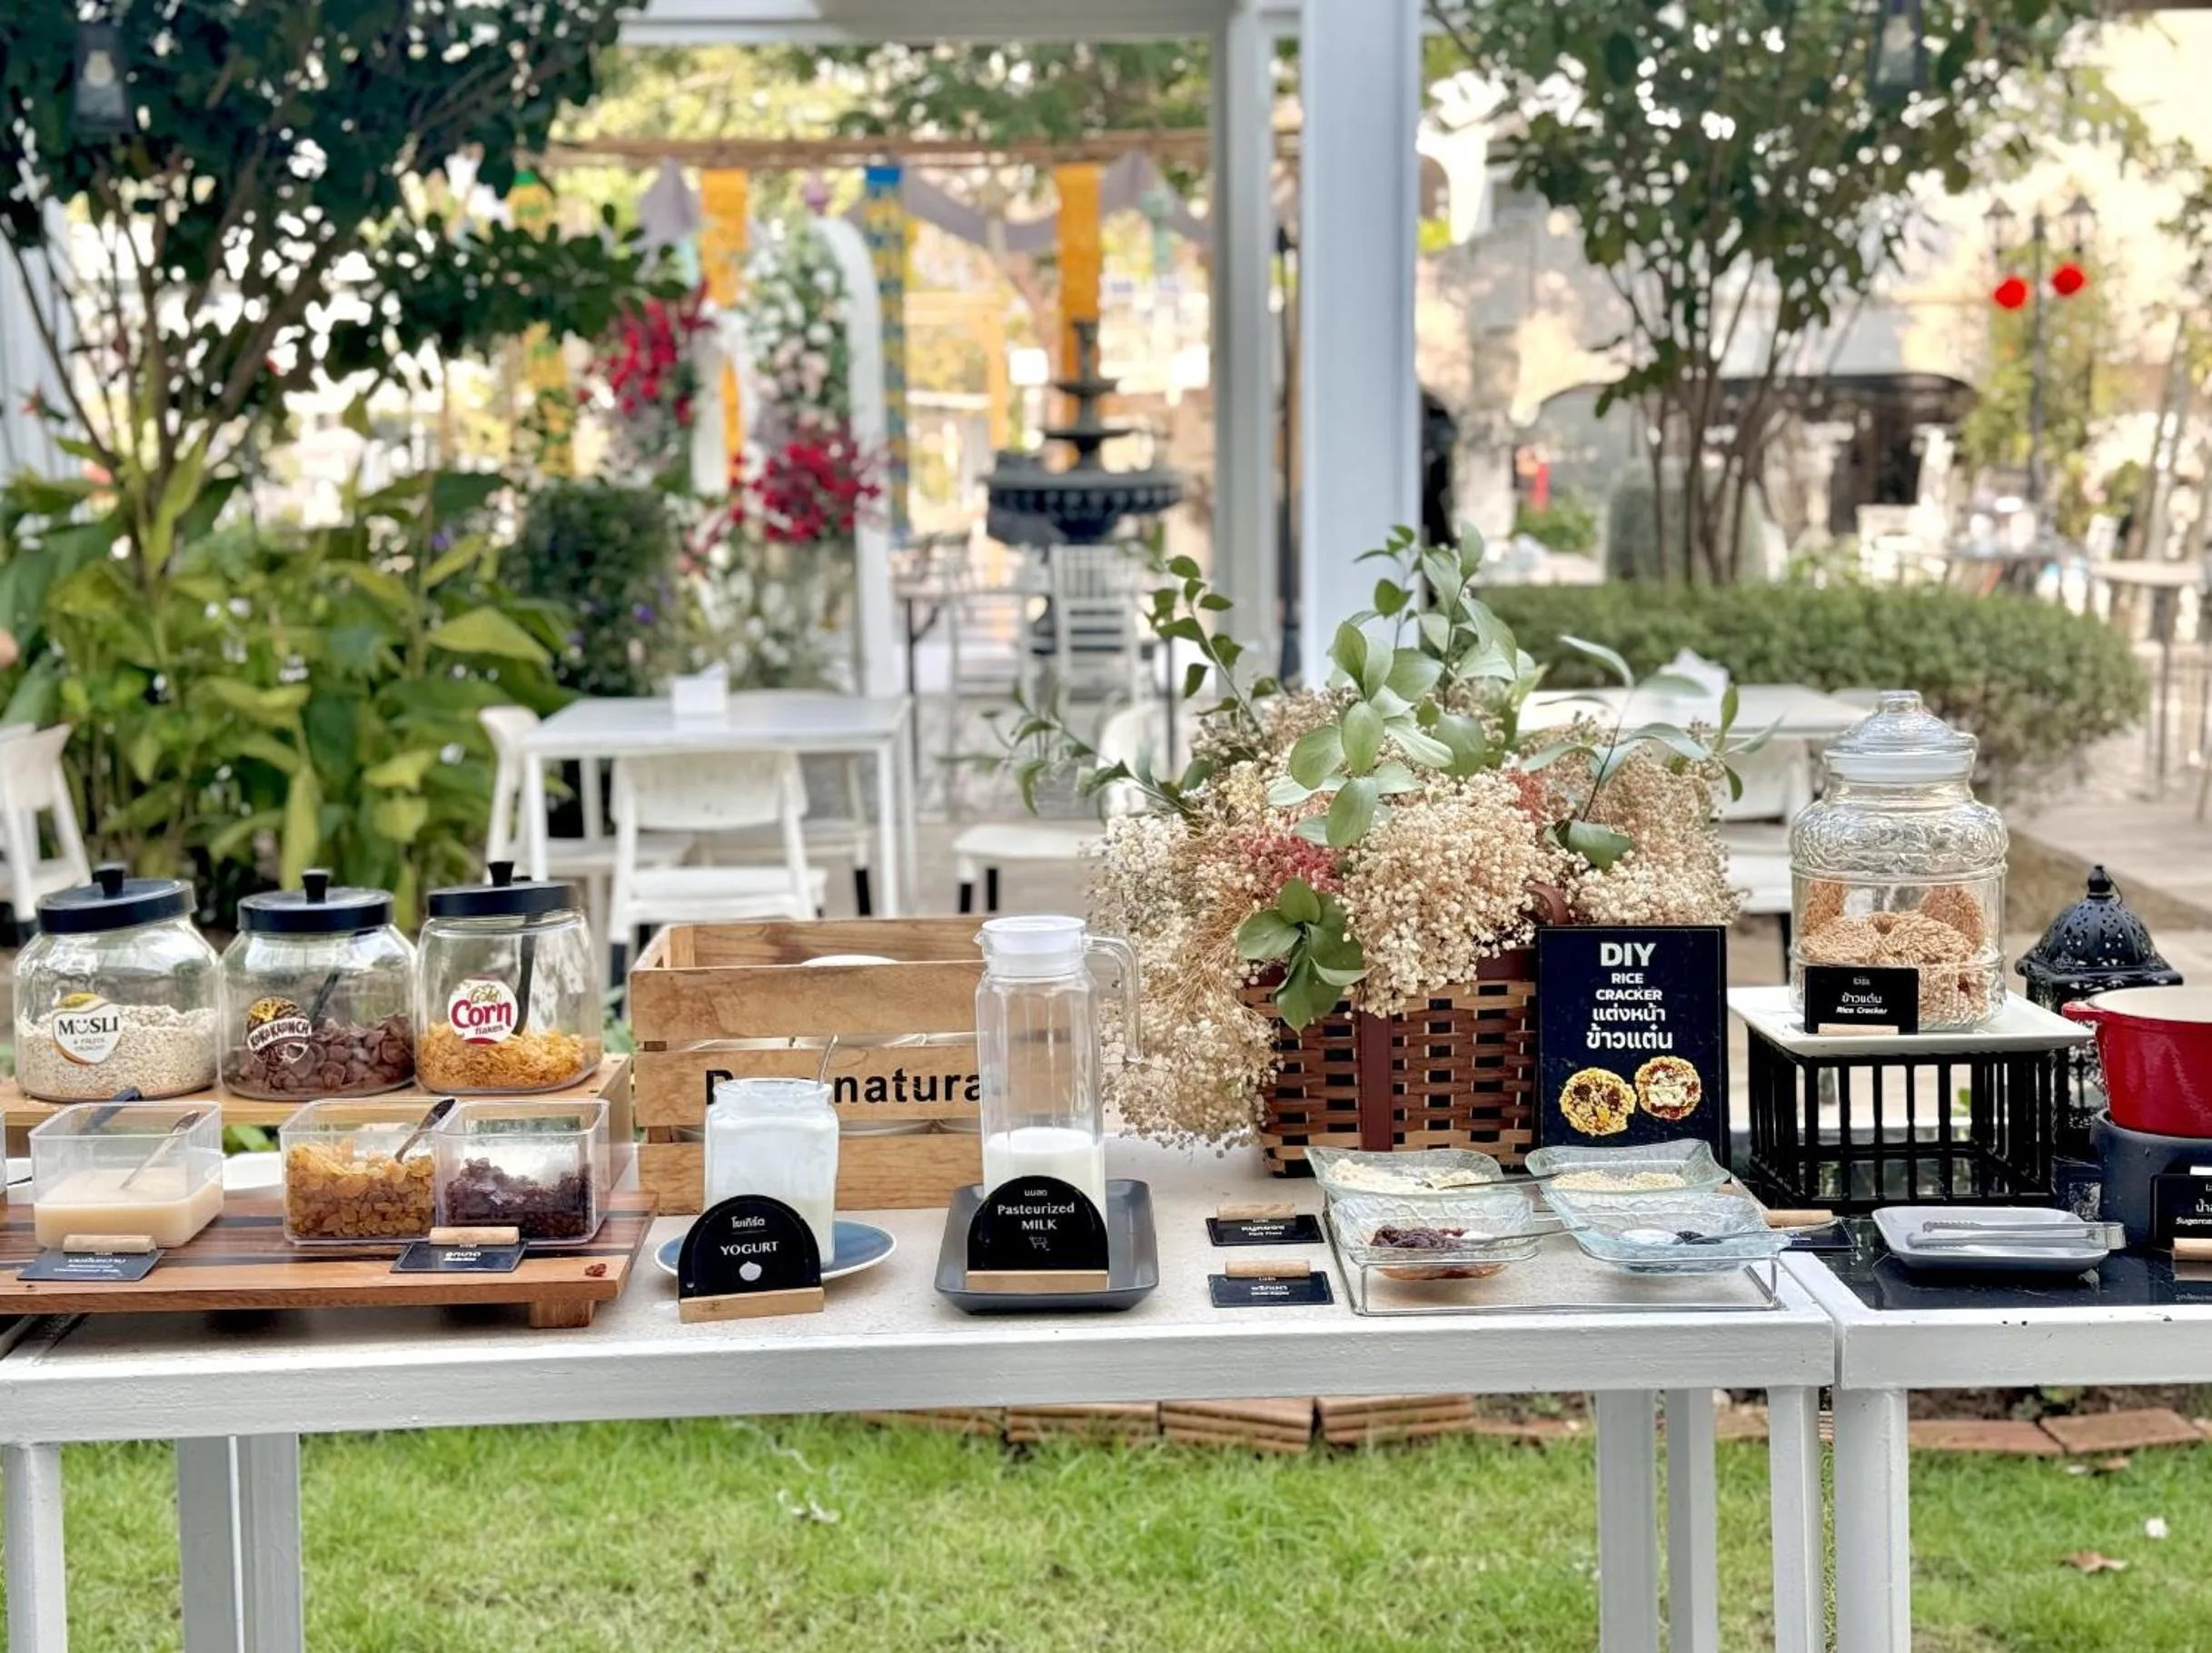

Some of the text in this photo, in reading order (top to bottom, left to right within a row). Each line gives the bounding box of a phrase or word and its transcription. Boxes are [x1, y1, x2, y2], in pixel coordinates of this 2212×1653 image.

[1600, 942, 1657, 966] DIY
[1611, 973, 1644, 985] RICE
[1595, 988, 1663, 1001] CRACKER
[451, 999, 511, 1029] Corn
[1592, 1002, 1666, 1021] แต่งหน้า
[58, 1015, 119, 1036] MÜSLI
[1586, 1023, 1673, 1049] ข้าวแต๋น
[833, 1067, 981, 1104] natura
[997, 1202, 1075, 1215] Pasteurized
[1021, 1219, 1057, 1231] MILK
[719, 1241, 779, 1256] YOGURT
